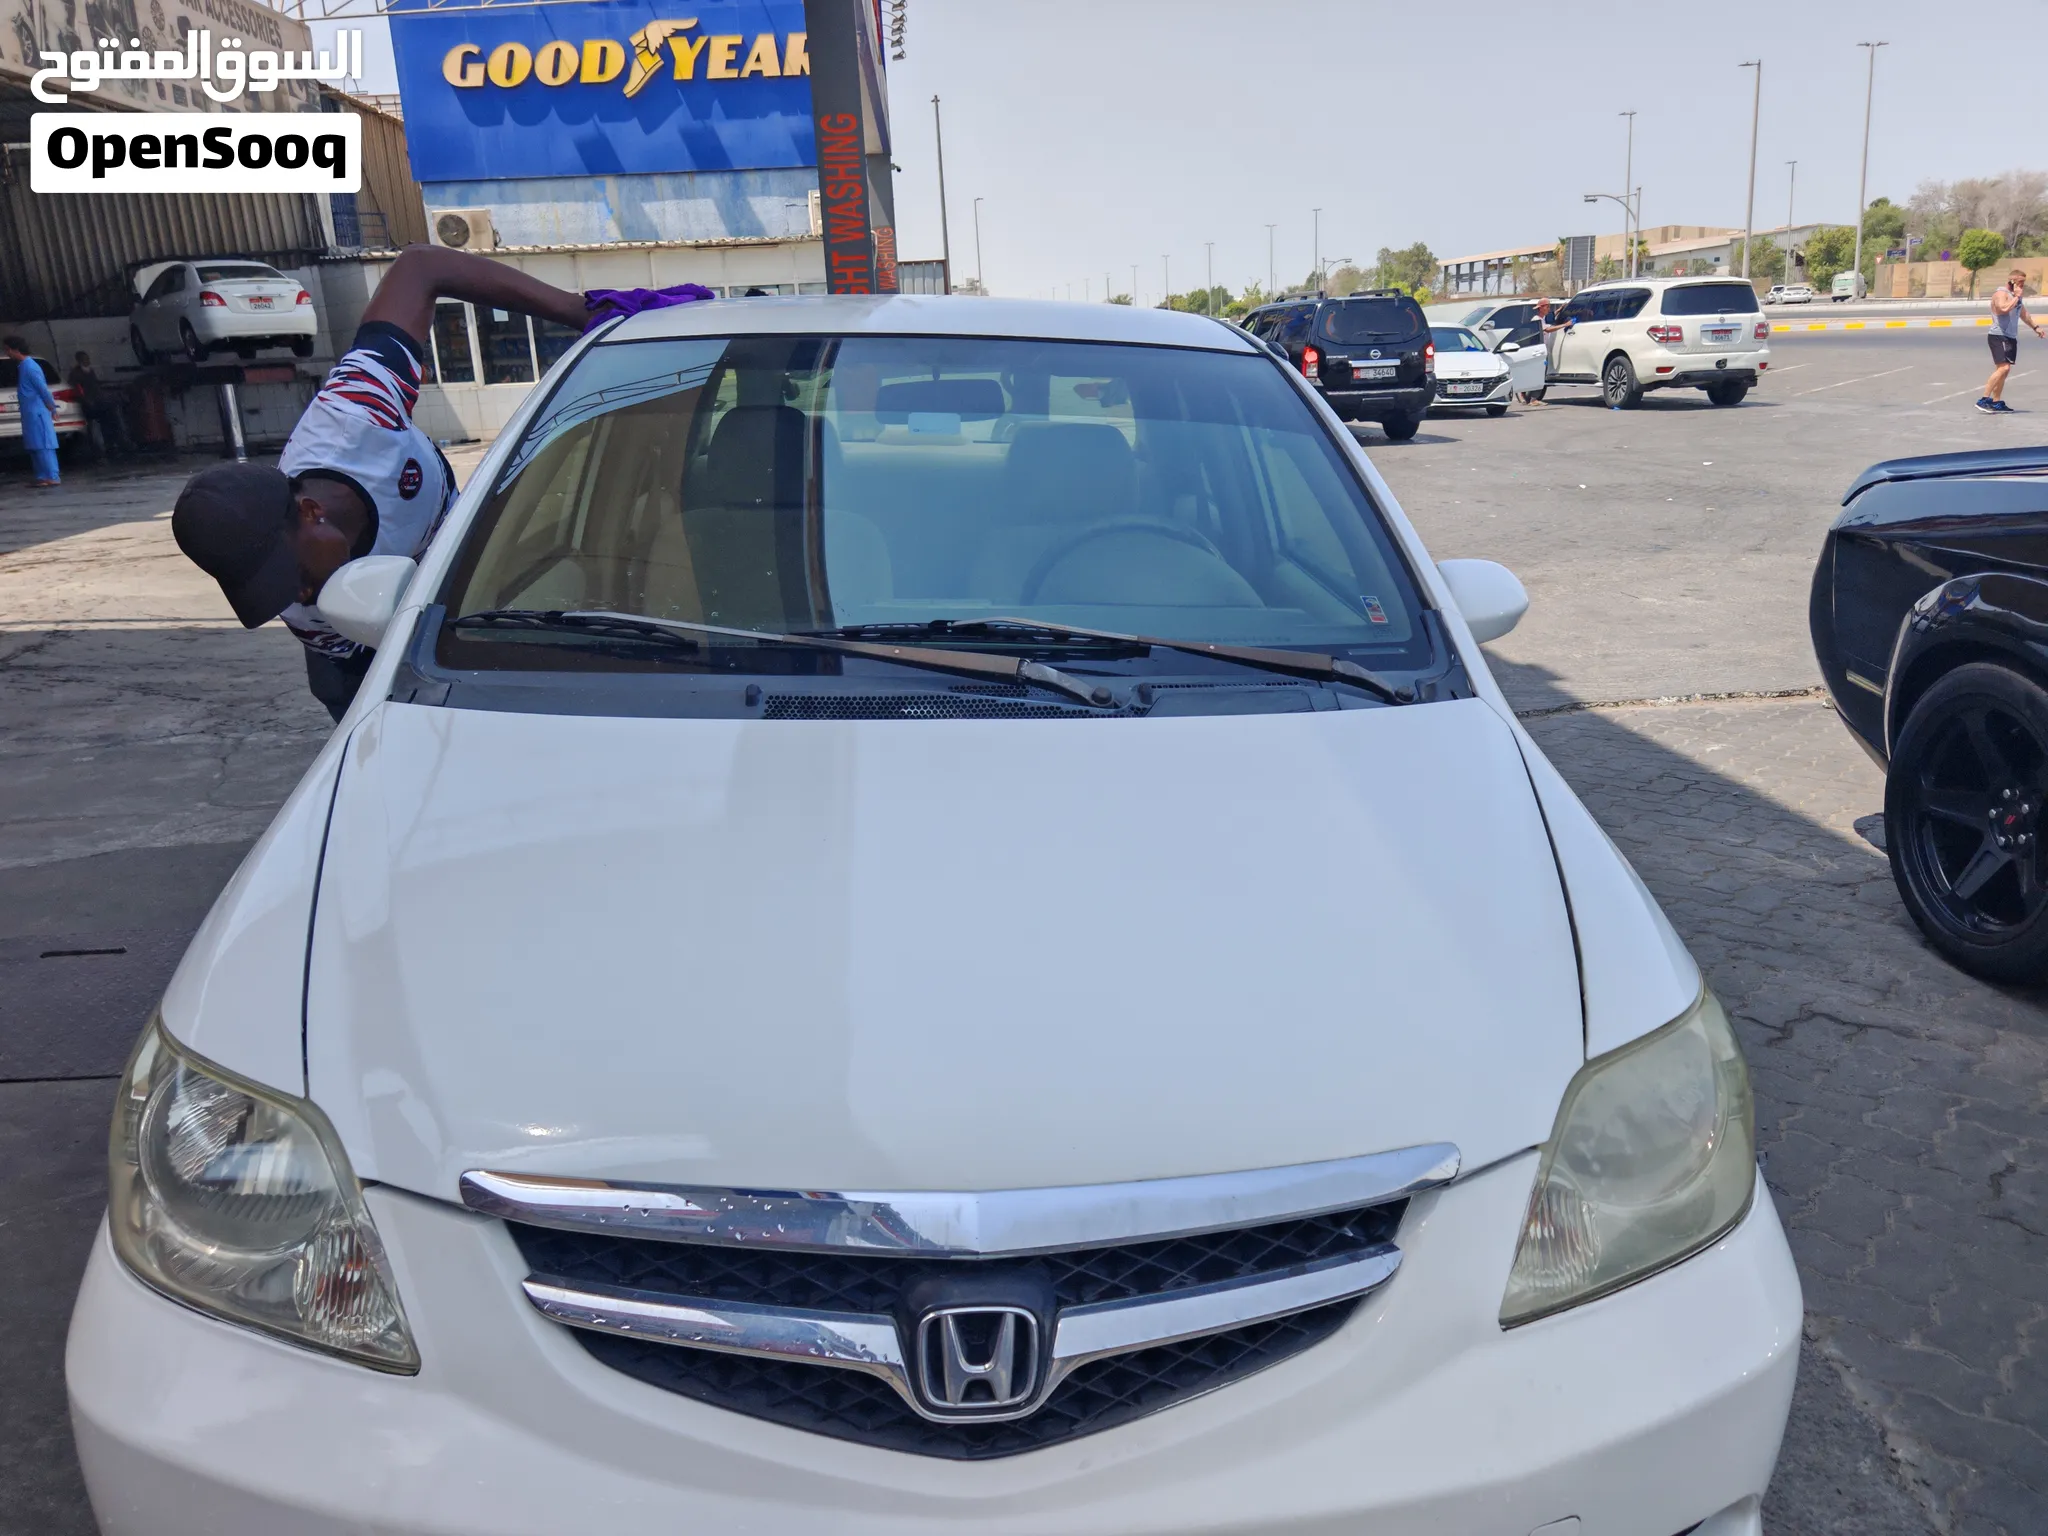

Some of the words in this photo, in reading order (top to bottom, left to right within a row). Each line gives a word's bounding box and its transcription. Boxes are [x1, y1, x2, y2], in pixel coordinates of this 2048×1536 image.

[820, 113, 866, 244] WASHING
[875, 227, 898, 290] WASHING
[1372, 366, 1394, 377] 34640
